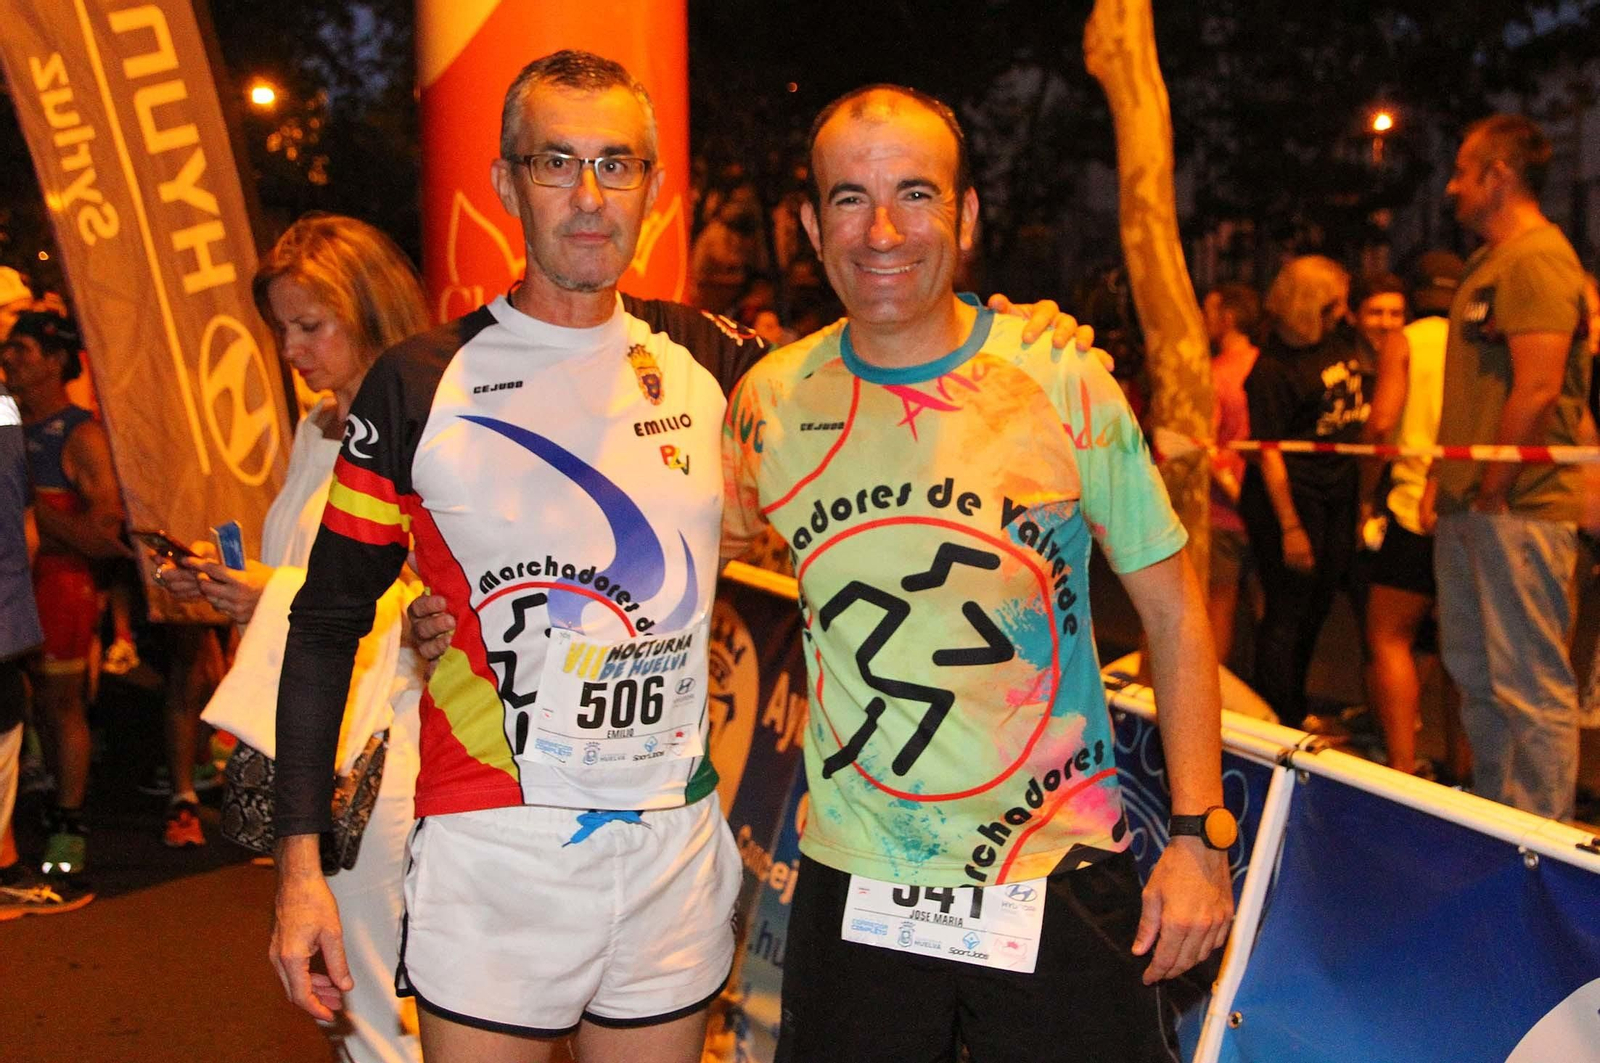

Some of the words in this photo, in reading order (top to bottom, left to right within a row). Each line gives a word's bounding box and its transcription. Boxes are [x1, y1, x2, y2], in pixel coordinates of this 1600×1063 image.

[473, 380, 524, 394] CEJUDO
[633, 413, 692, 437] EMILIO
[927, 477, 981, 516] de
[479, 555, 640, 612] Marchadores
[606, 633, 693, 662] NOCTURNA
[598, 660, 627, 681] DE
[627, 652, 688, 677] HUELVA
[577, 675, 665, 729] 506
[607, 728, 635, 739] EMILIO
[959, 740, 1104, 886] rchadores
[909, 909, 931, 923] JOSE
[933, 913, 964, 927] MARIA
